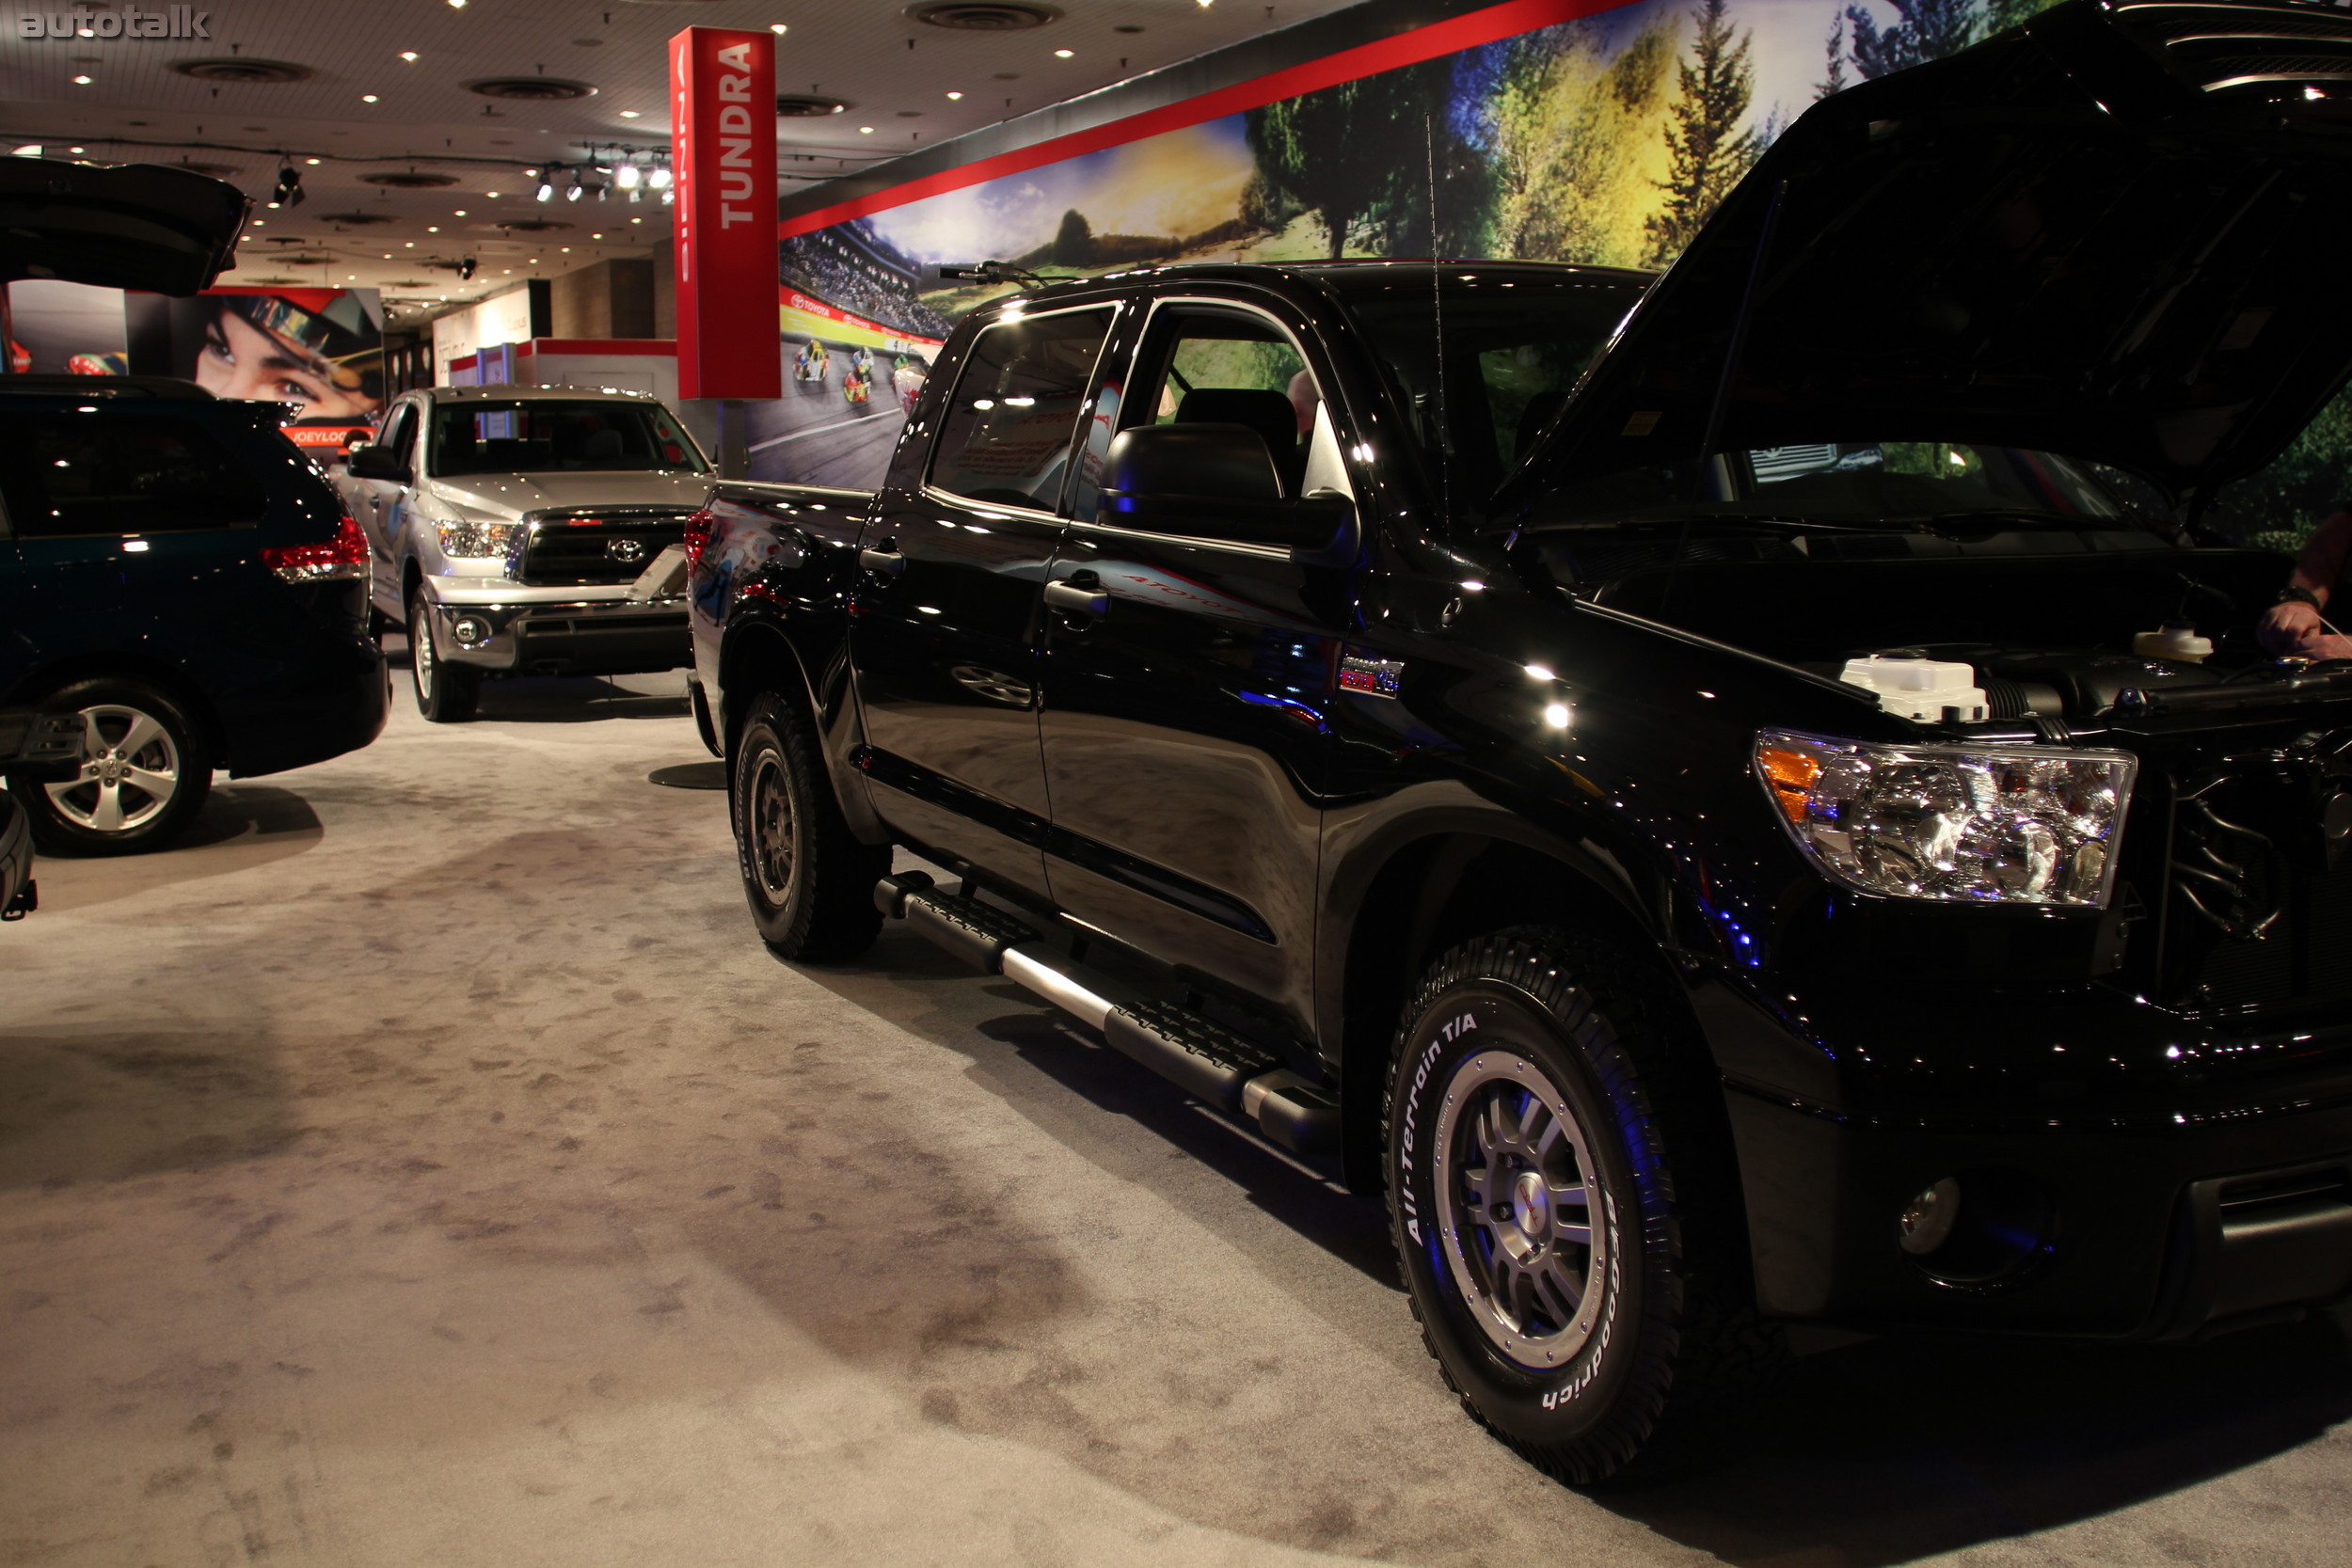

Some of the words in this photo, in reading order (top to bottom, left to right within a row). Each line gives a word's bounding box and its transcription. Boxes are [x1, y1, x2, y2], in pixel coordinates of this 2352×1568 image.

[718, 42, 754, 230] TUNDRA
[803, 300, 830, 318] TOYOTA
[294, 431, 373, 443] JOEYLOG
[1401, 1039, 1442, 1247] All-Terrain
[1441, 1013, 1478, 1044] T/A
[1541, 1190, 1621, 1411] BFGoodrich
